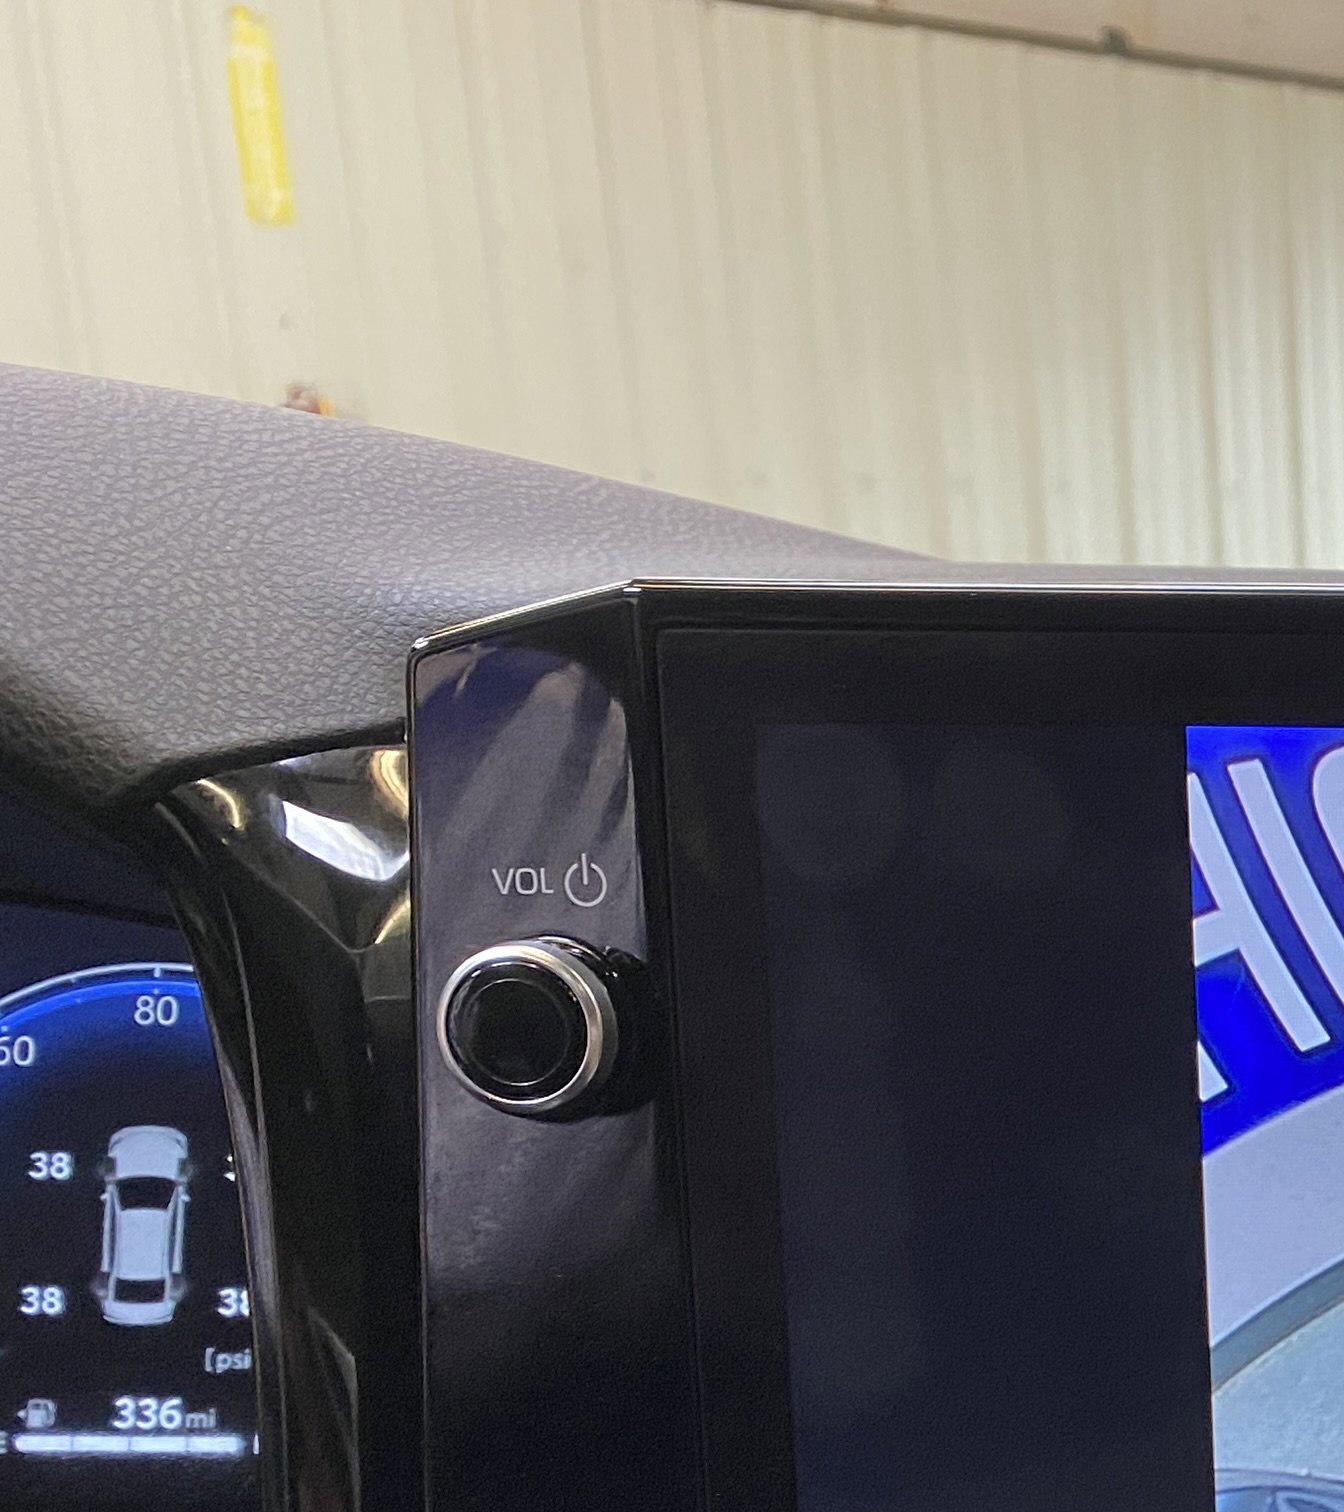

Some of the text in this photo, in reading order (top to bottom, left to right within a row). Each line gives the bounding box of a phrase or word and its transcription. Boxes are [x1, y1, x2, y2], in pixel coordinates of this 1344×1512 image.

[491, 866, 554, 895] VOL
[134, 995, 179, 1026] 80
[28, 1151, 72, 1181] 38
[19, 1285, 64, 1316] 38
[112, 1395, 217, 1430] 336 mi
